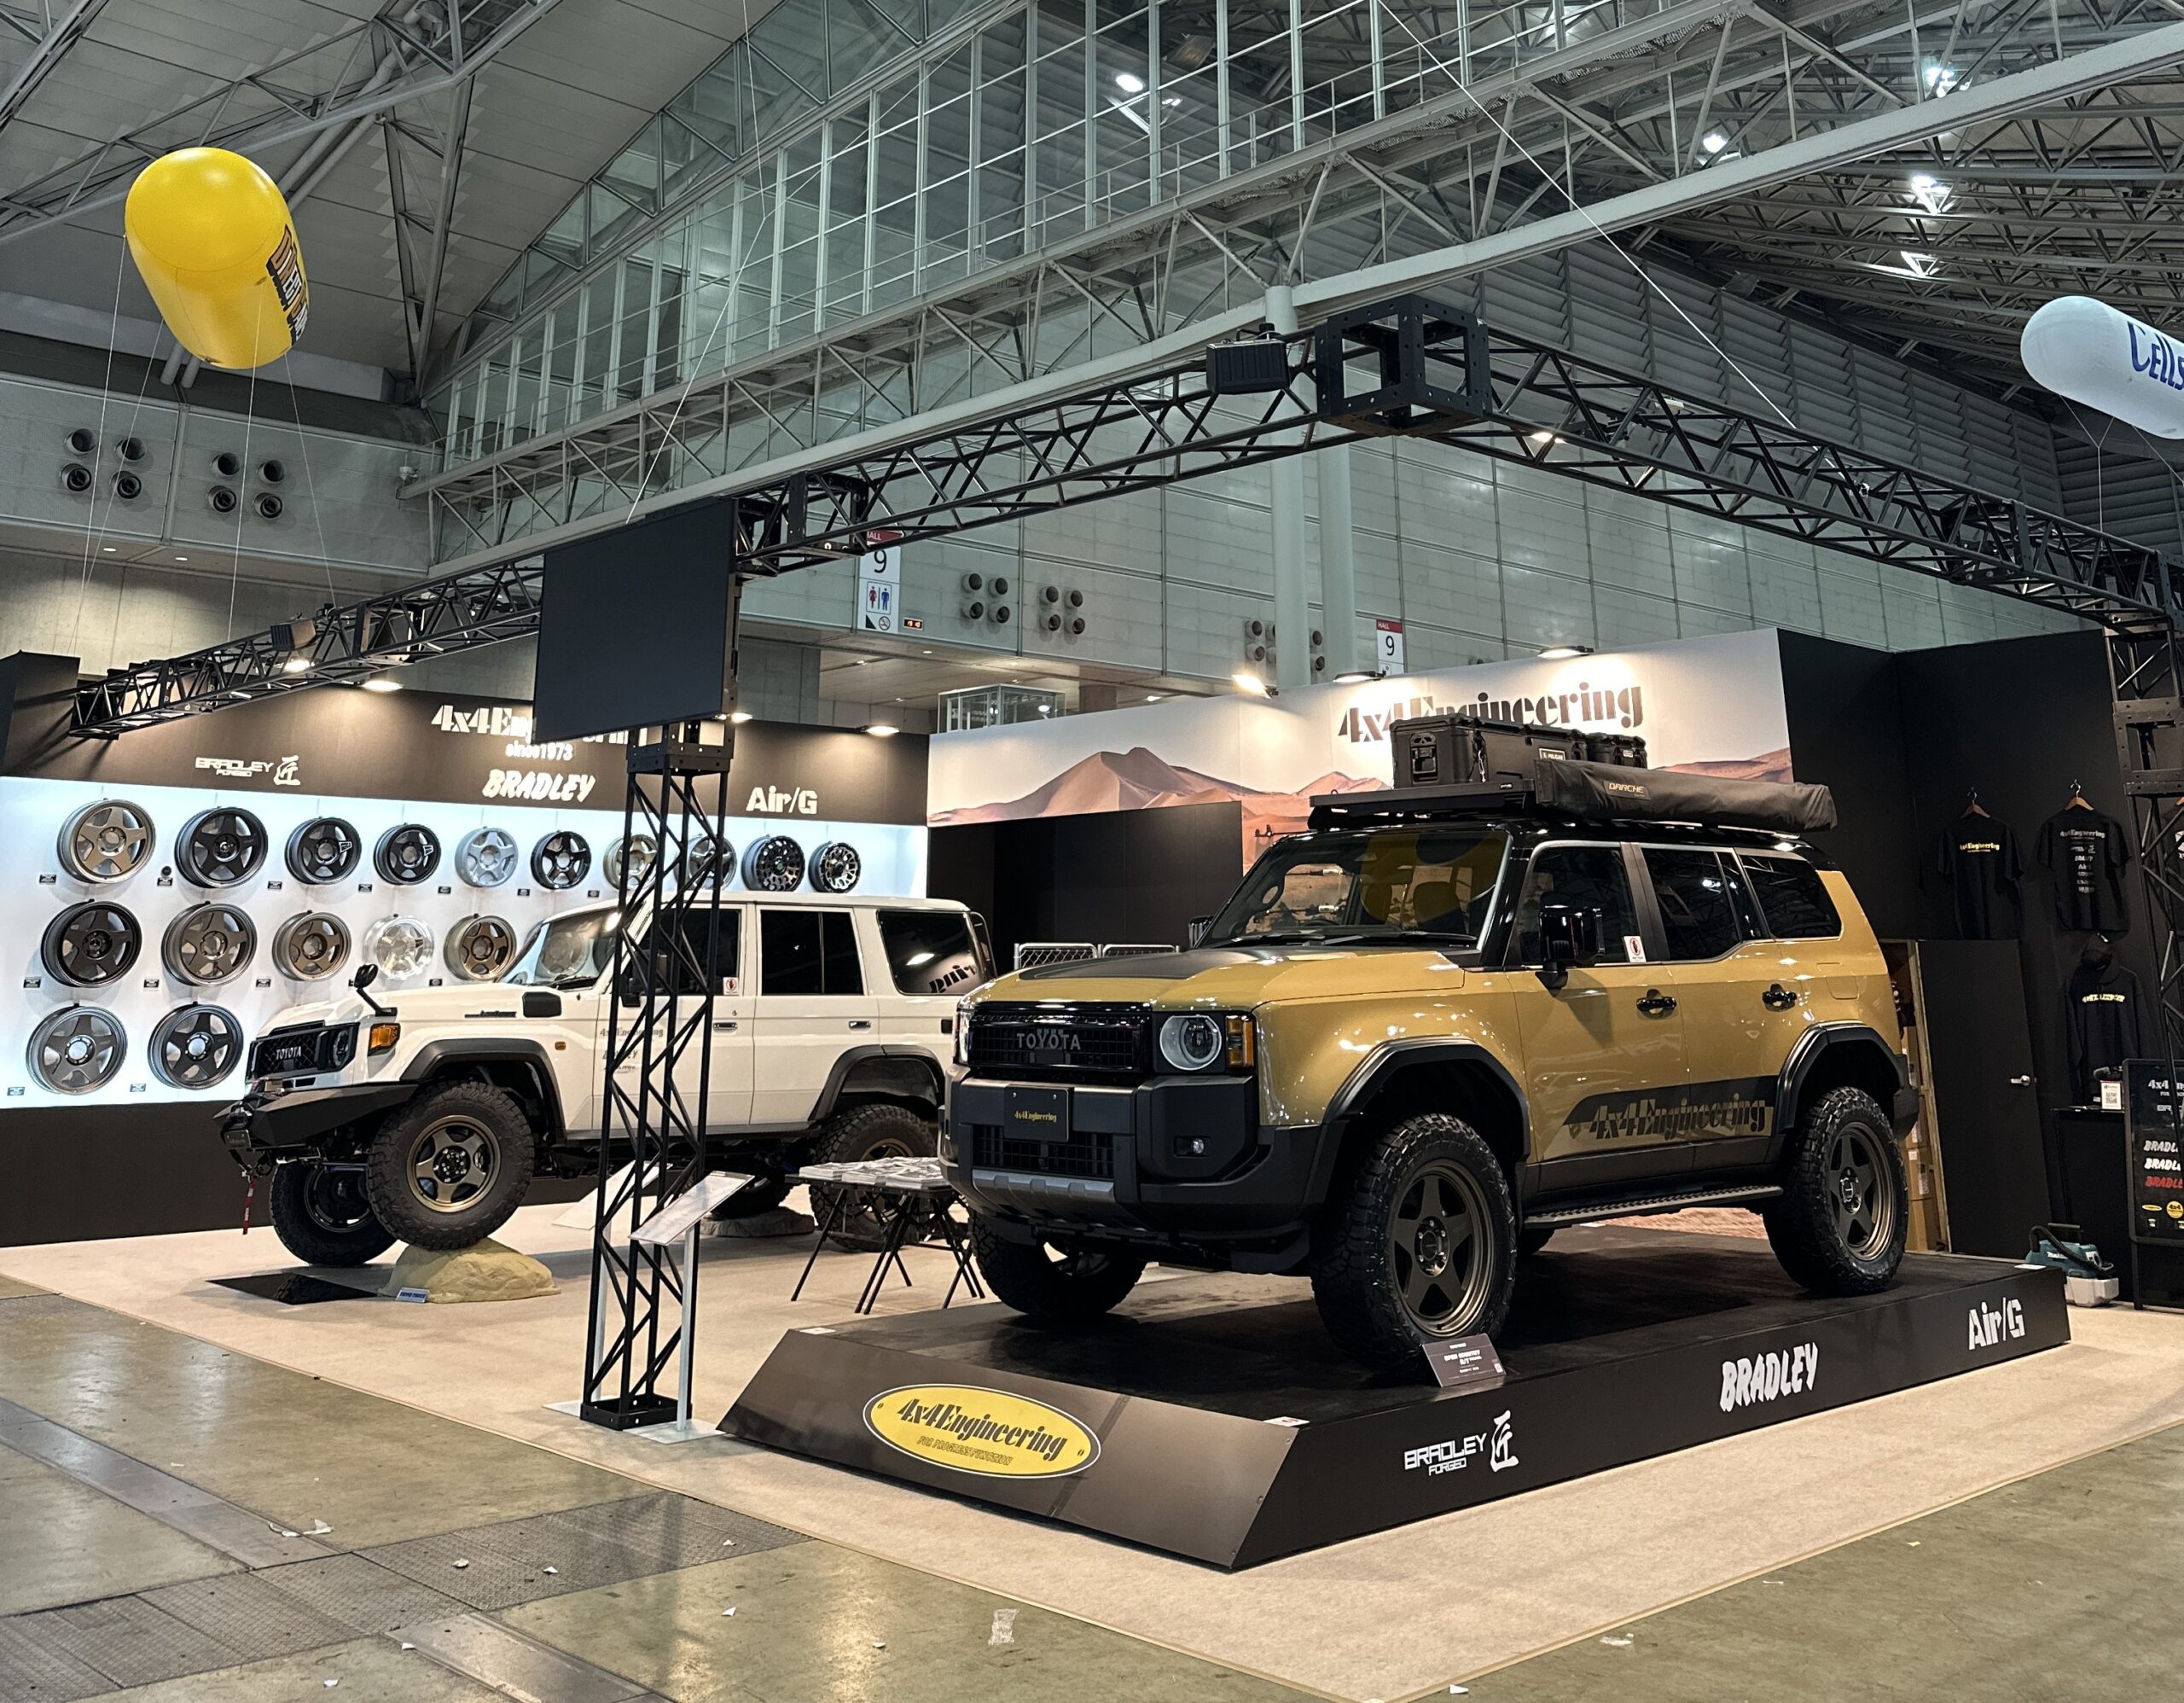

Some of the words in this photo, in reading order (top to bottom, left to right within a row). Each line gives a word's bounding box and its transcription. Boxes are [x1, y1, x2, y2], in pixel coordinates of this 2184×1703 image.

[874, 549, 887, 573] 9
[1378, 621, 1391, 630] HALL
[1385, 635, 1395, 656] 9
[195, 757, 274, 772] BRADLEY
[481, 769, 596, 802] BRADLEY
[1609, 782, 1645, 793] DARCHE
[746, 785, 818, 814] Air/G
[1016, 1032, 1081, 1050] TOYOTA
[276, 1046, 302, 1061] TOYOTA
[1589, 1092, 1766, 1141] 4x4Engineering
[1967, 1296, 2026, 1351] Air/G
[1719, 1341, 1819, 1413] BRADLEY
[897, 1398, 1068, 1462] 4x4Engineering
[916, 1435, 934, 1448] FOR
[1403, 1433, 1488, 1470] BRADLEY
[1428, 1457, 1467, 1477] FORGED
